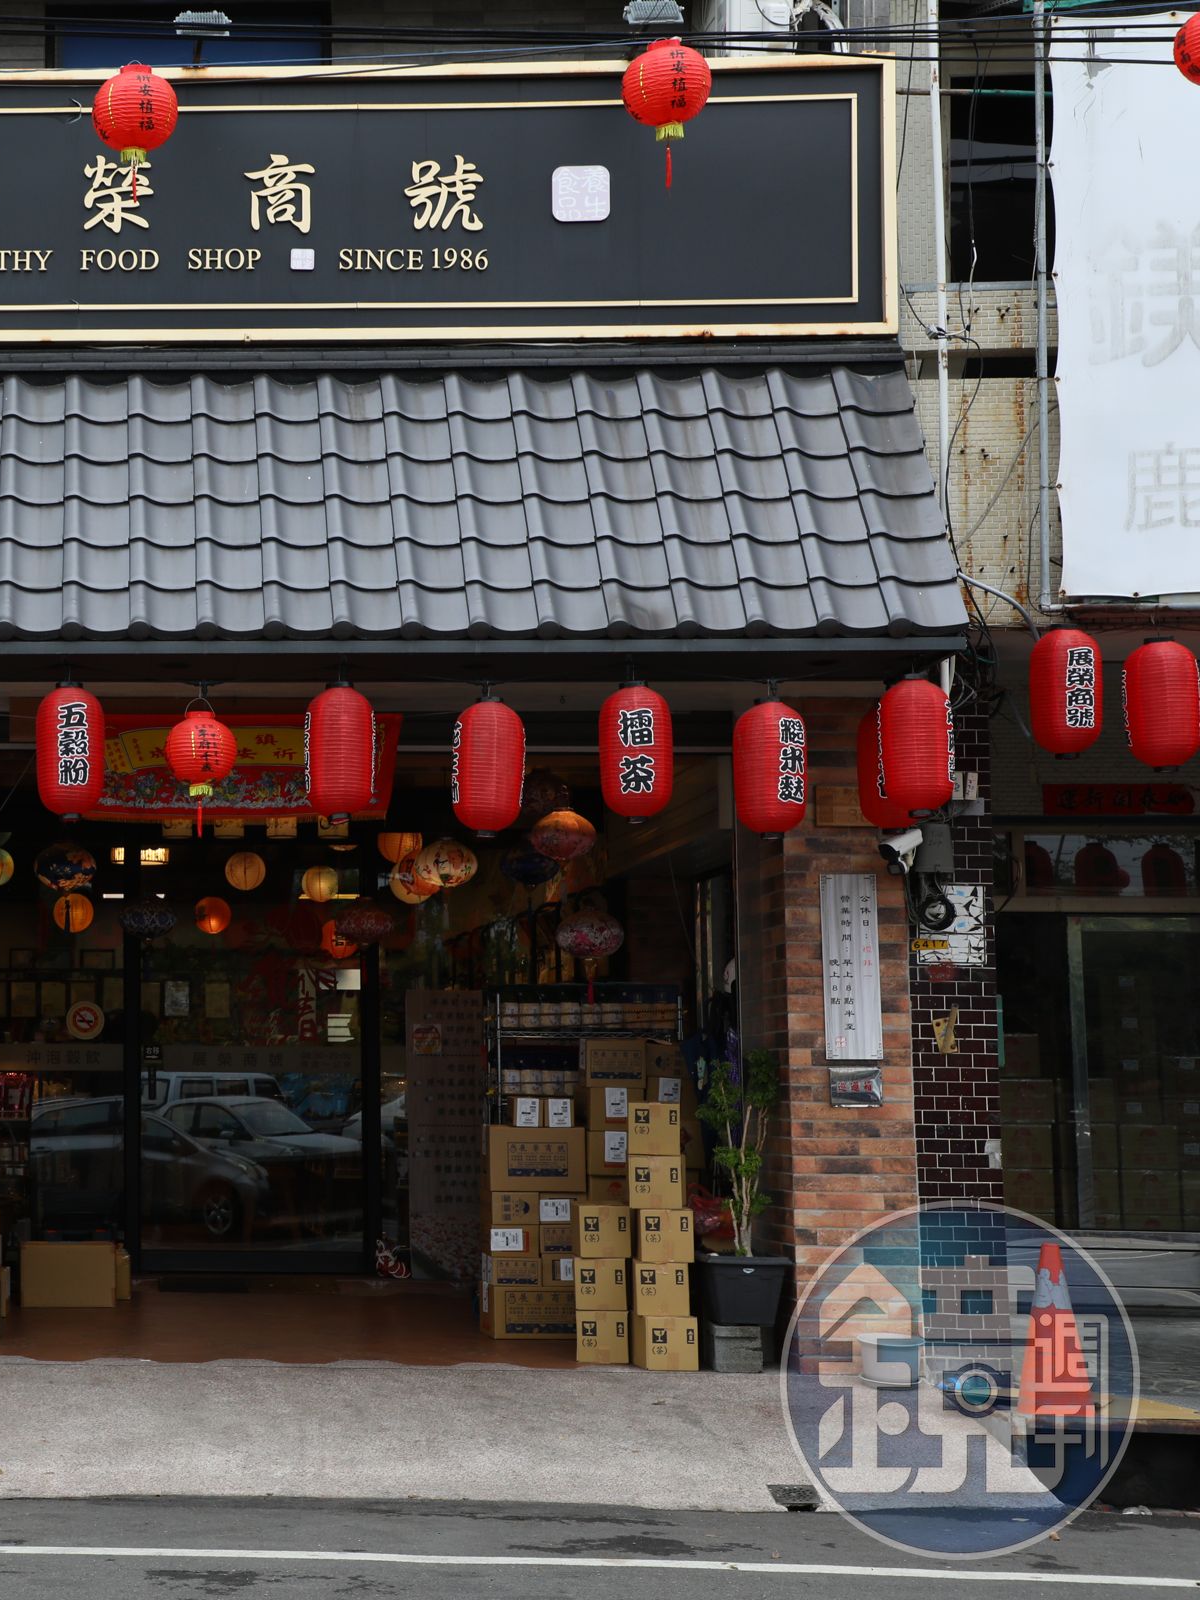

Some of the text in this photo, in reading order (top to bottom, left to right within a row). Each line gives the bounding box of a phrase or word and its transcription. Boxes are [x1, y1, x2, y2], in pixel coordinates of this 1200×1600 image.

[80, 249, 160, 271] FOOD
[187, 248, 262, 272] SHOP
[339, 248, 424, 271] SINCE
[431, 247, 489, 271] 1986
[1066, 646, 1095, 729] 展榮商號
[57, 702, 89, 786] 五穀粉
[618, 708, 655, 794] 擂茶
